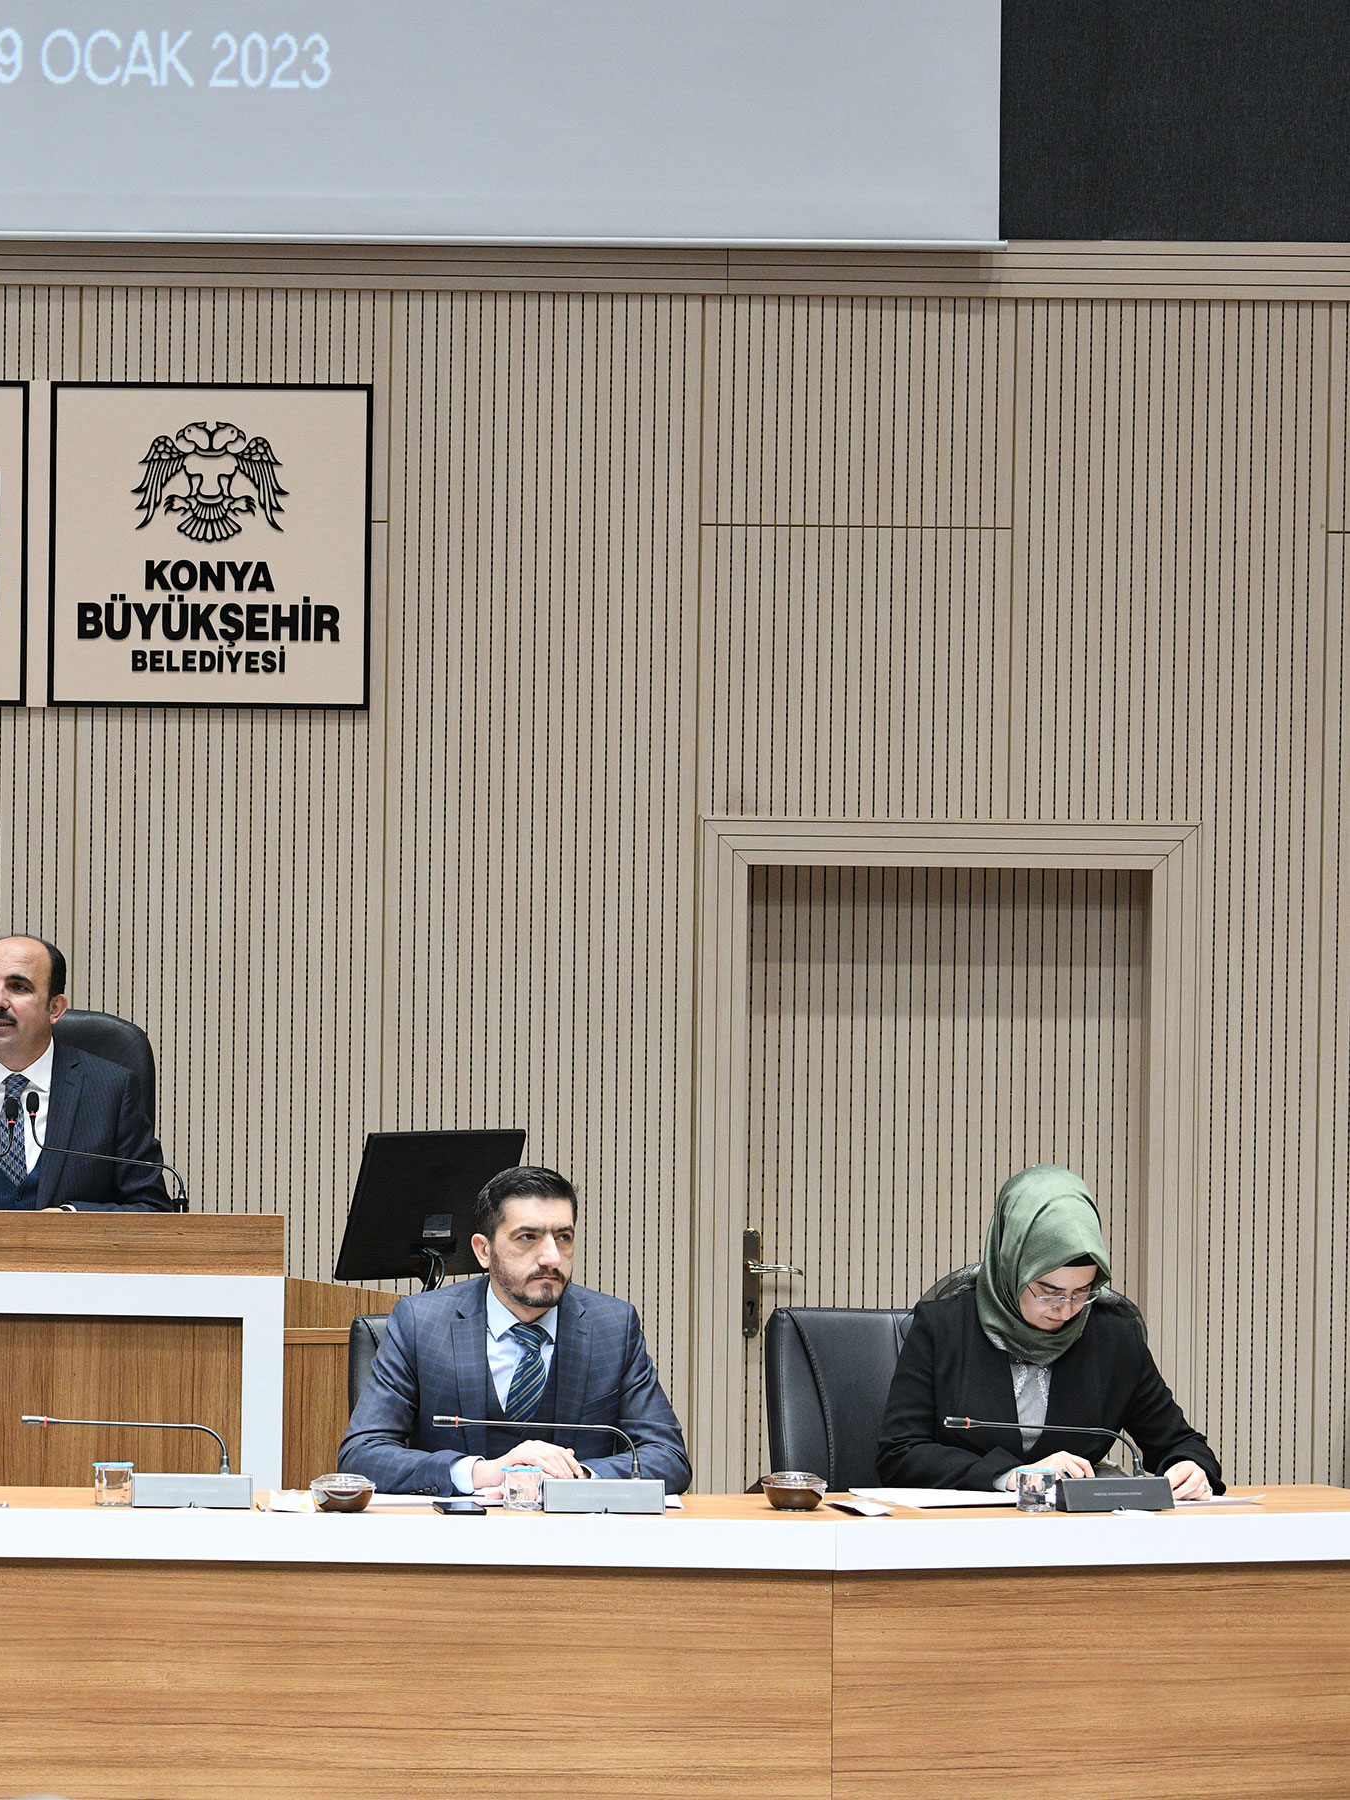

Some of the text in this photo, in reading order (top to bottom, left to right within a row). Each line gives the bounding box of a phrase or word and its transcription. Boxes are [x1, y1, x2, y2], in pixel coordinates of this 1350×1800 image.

[41, 29, 195, 87] OCAK
[209, 32, 332, 89] 2023
[144, 559, 276, 592] KONYA
[76, 593, 341, 648] BÜYÜKŞEHİR
[131, 645, 286, 674] BELEDİYESİ
